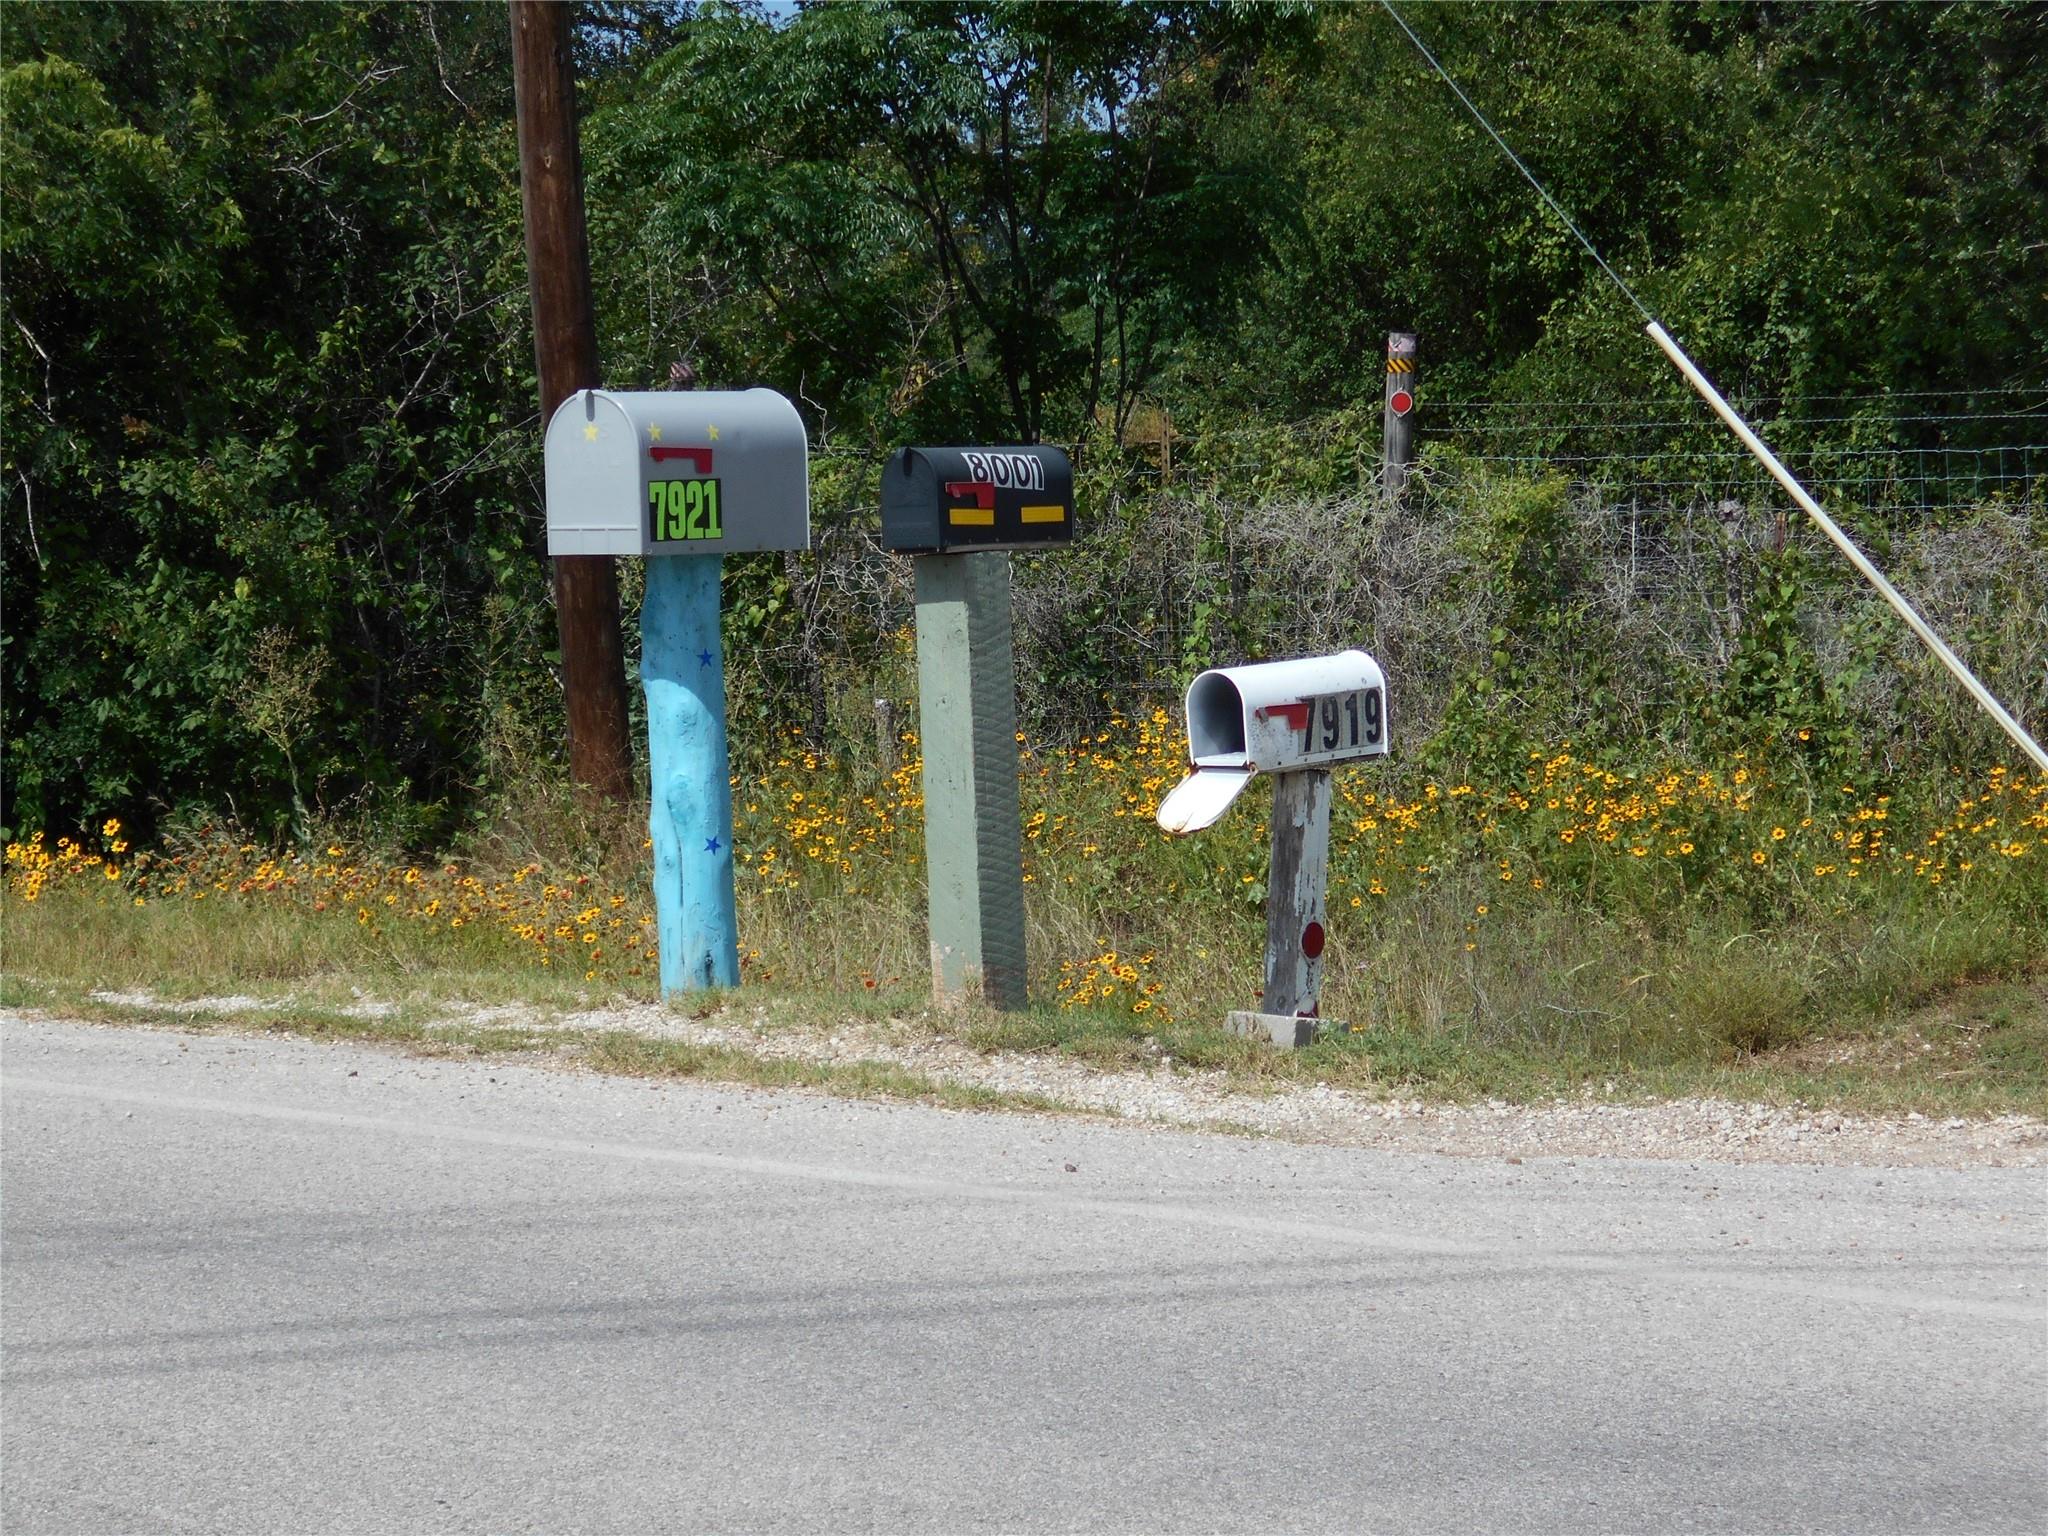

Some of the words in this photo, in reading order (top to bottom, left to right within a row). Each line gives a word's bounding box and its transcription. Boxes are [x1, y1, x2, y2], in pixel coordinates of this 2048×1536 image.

[967, 453, 1043, 490] 8001
[650, 480, 722, 541] 7921
[1300, 689, 1381, 752] 7919
